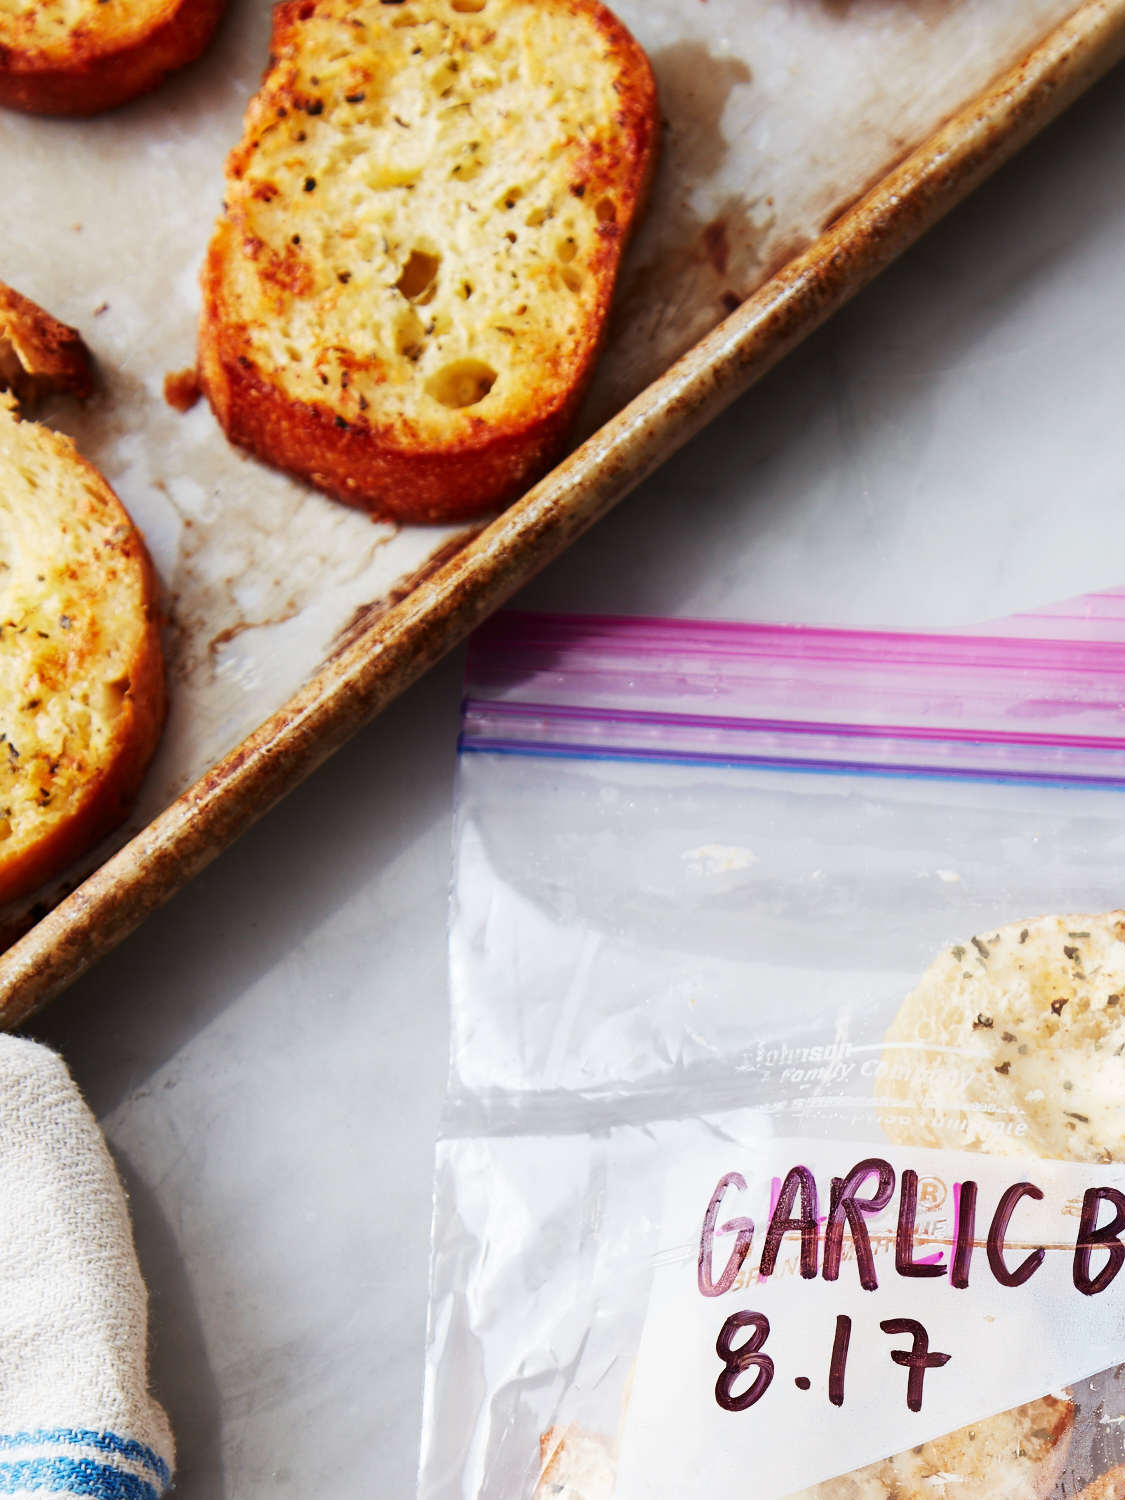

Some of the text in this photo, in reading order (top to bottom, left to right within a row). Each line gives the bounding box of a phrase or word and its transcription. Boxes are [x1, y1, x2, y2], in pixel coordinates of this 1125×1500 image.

[859, 1059, 977, 1092] Company
[697, 1157, 1045, 1298] GARLIC
[714, 1309, 952, 1412] 8.17
